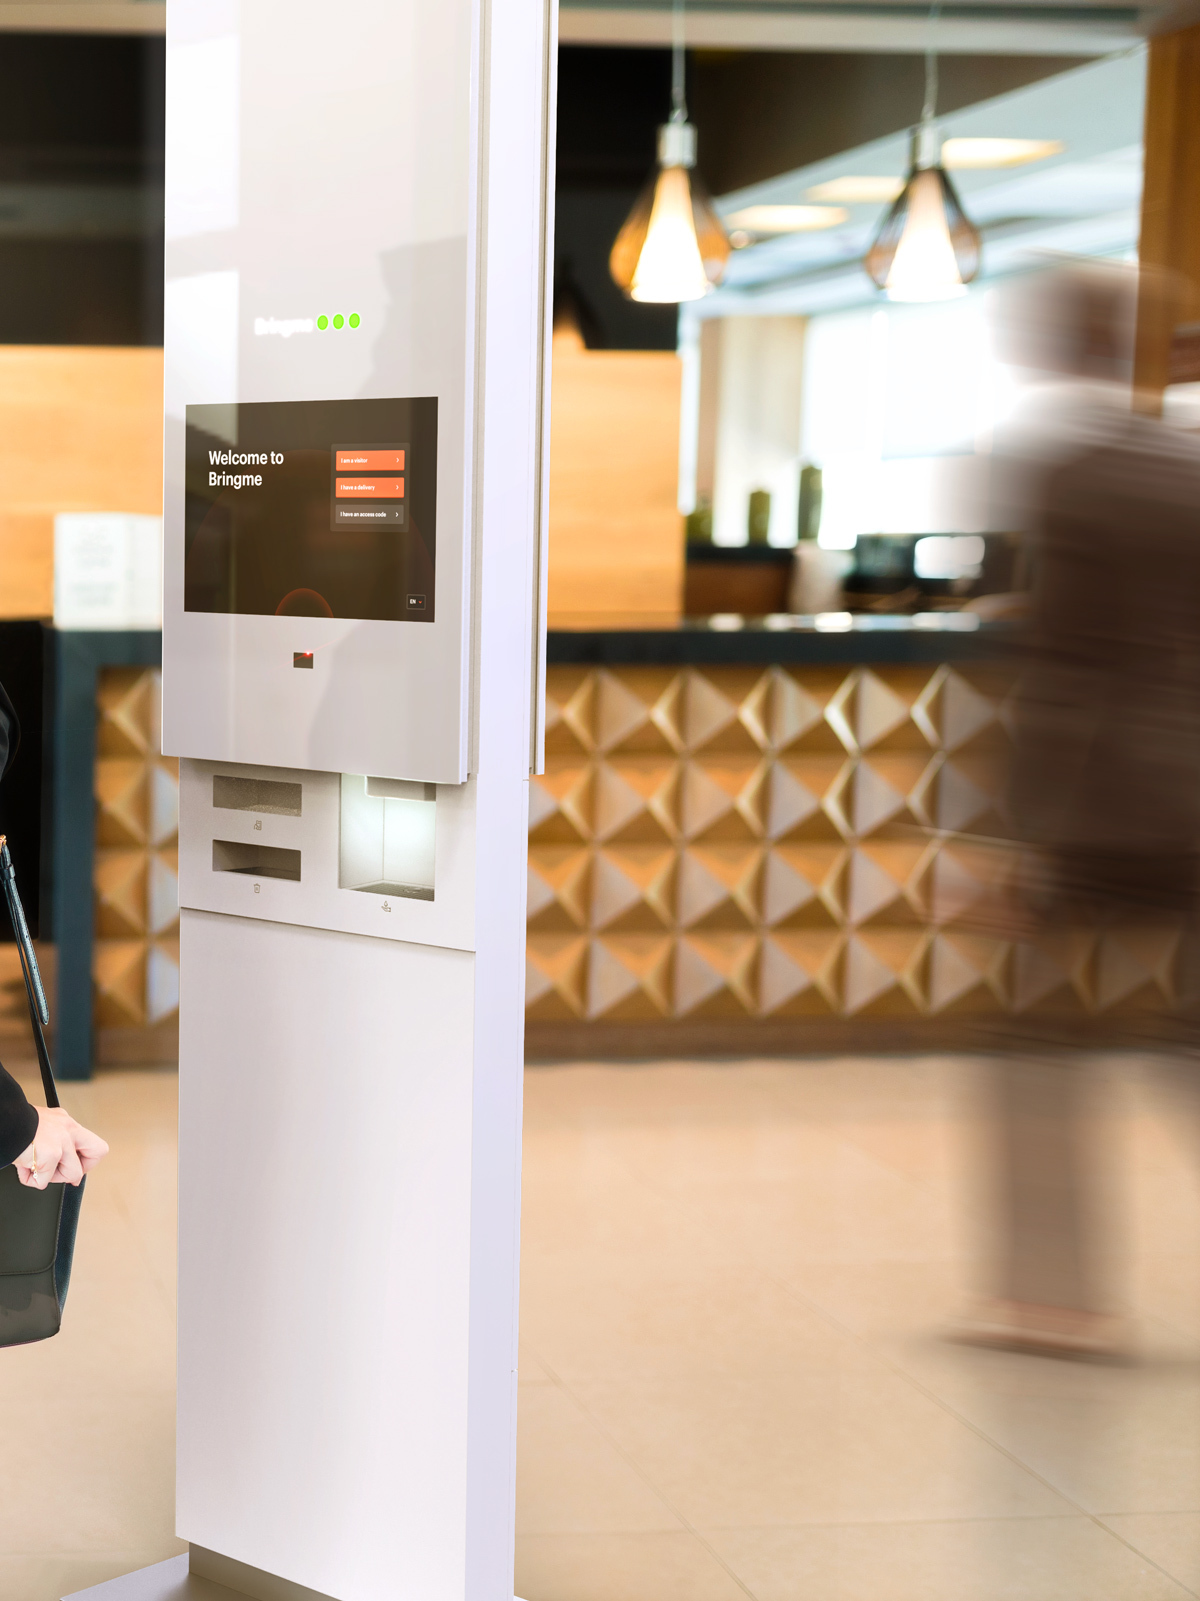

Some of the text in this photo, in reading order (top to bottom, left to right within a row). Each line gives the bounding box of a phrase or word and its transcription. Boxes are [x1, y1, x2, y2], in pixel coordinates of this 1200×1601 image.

[208, 449, 284, 466] Welcome to
[208, 470, 263, 490] Bringme
